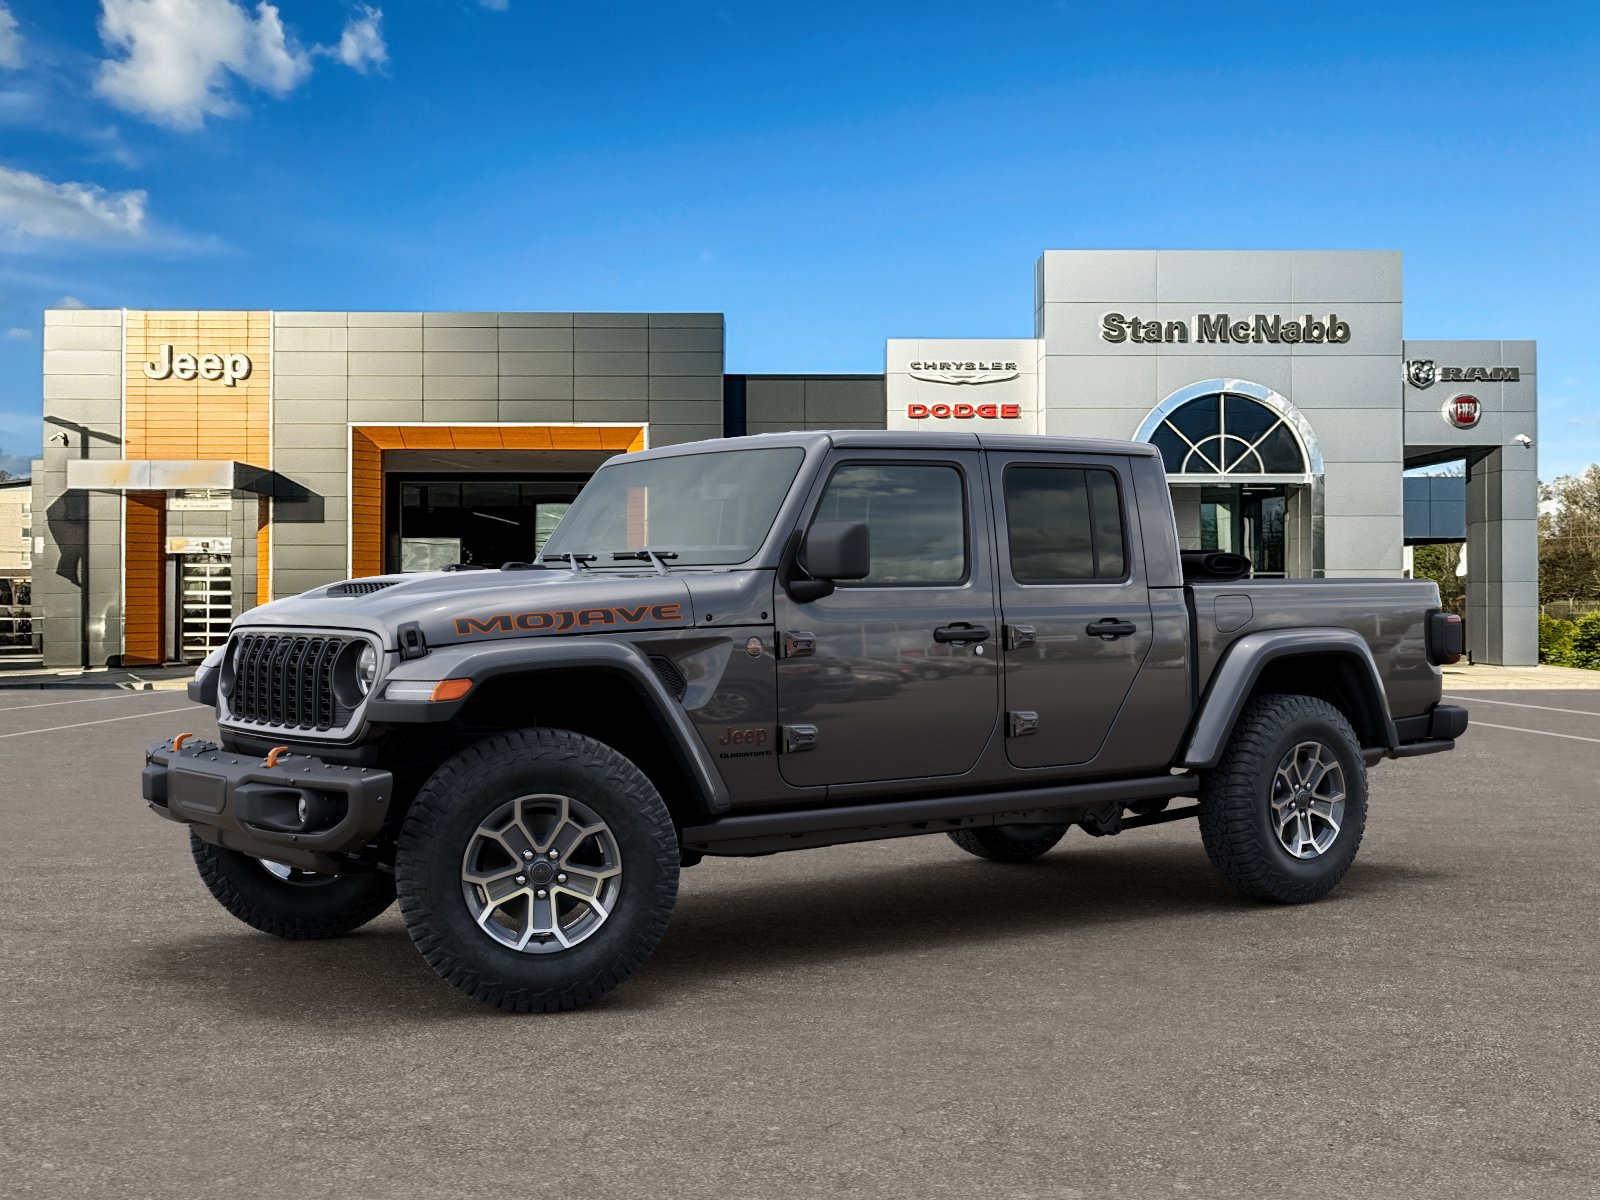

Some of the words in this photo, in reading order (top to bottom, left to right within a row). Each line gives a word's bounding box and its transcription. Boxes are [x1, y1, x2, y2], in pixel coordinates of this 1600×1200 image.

[1102, 312, 1188, 343] Stan
[1195, 312, 1351, 343] McNabb
[143, 344, 252, 387] Jeep
[909, 360, 1018, 371] CHRYSLER
[1441, 367, 1520, 382] RAM
[908, 403, 1021, 419] DODGE
[454, 604, 682, 635] MOJAVE
[717, 726, 767, 746] Jeep
